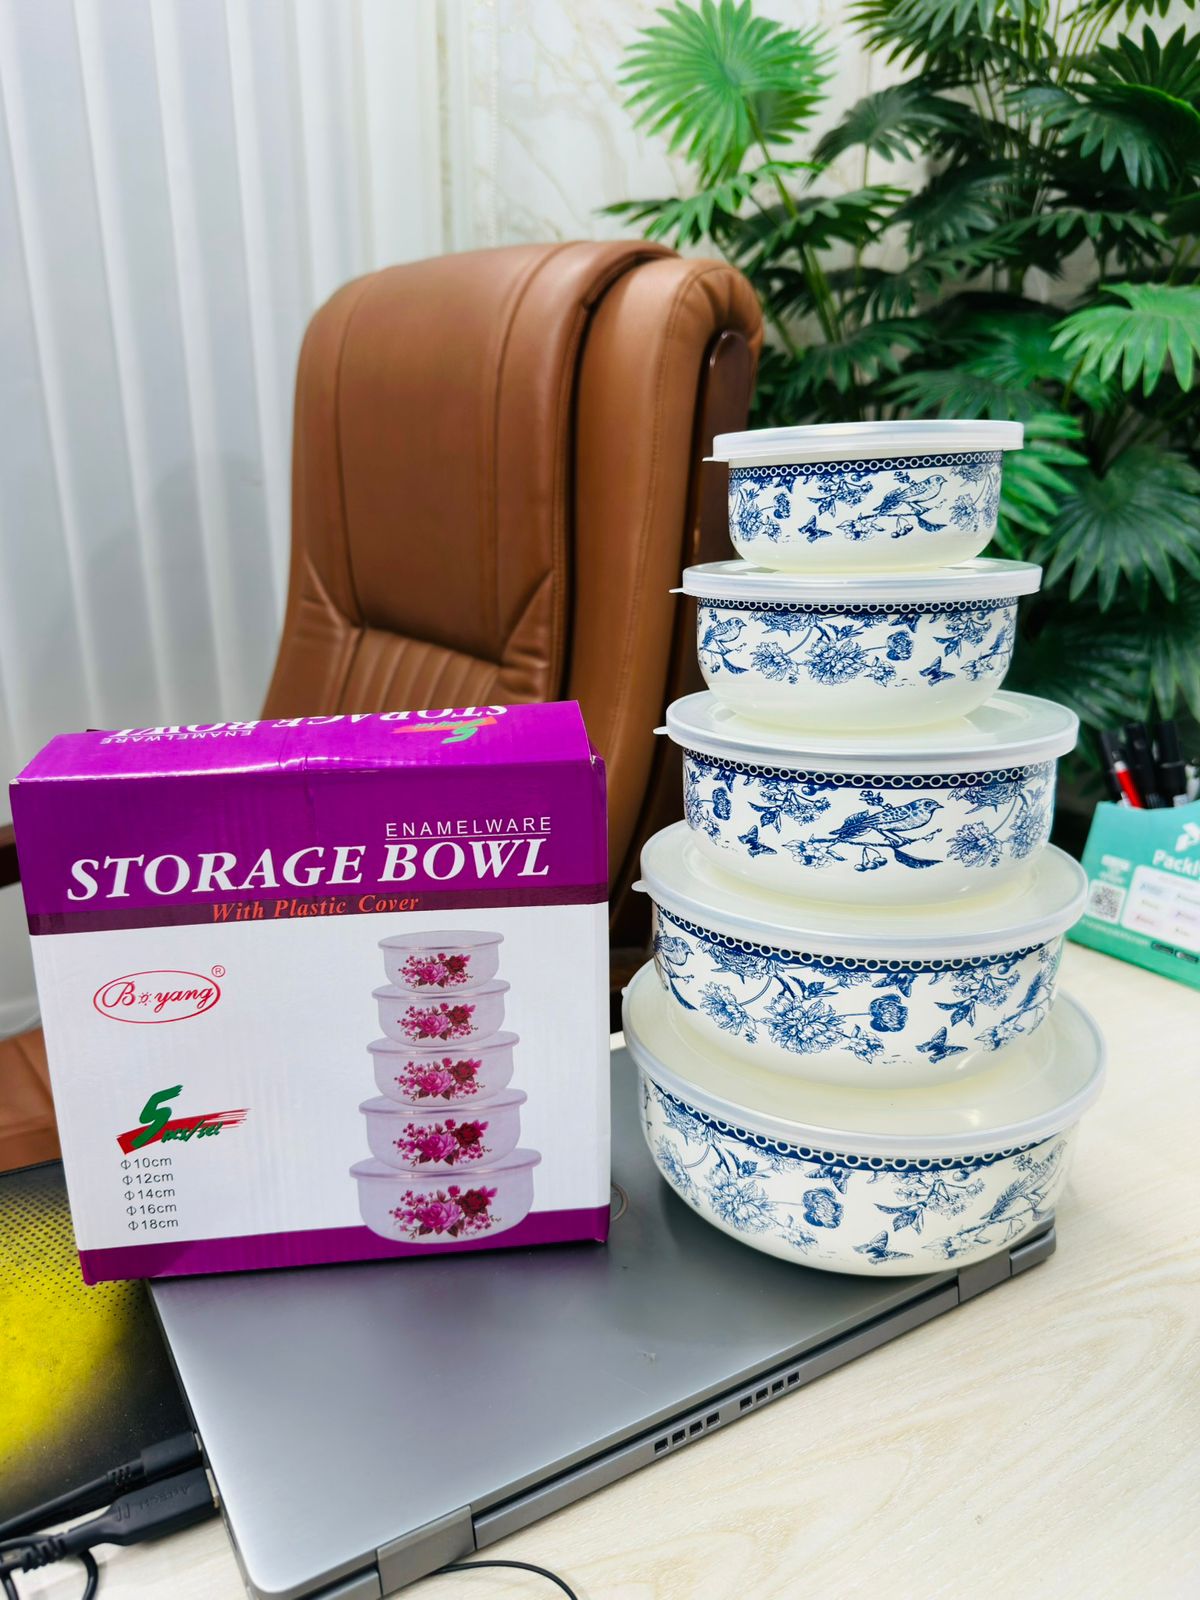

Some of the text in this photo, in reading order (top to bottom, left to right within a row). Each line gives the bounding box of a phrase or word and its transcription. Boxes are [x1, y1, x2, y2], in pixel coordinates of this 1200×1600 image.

[100, 730, 252, 745] ENAMELWARE
[385, 817, 551, 837] ENAMELWARE
[67, 838, 550, 901] STORAGE BOWL
[212, 894, 419, 922] With Plastic Cover
